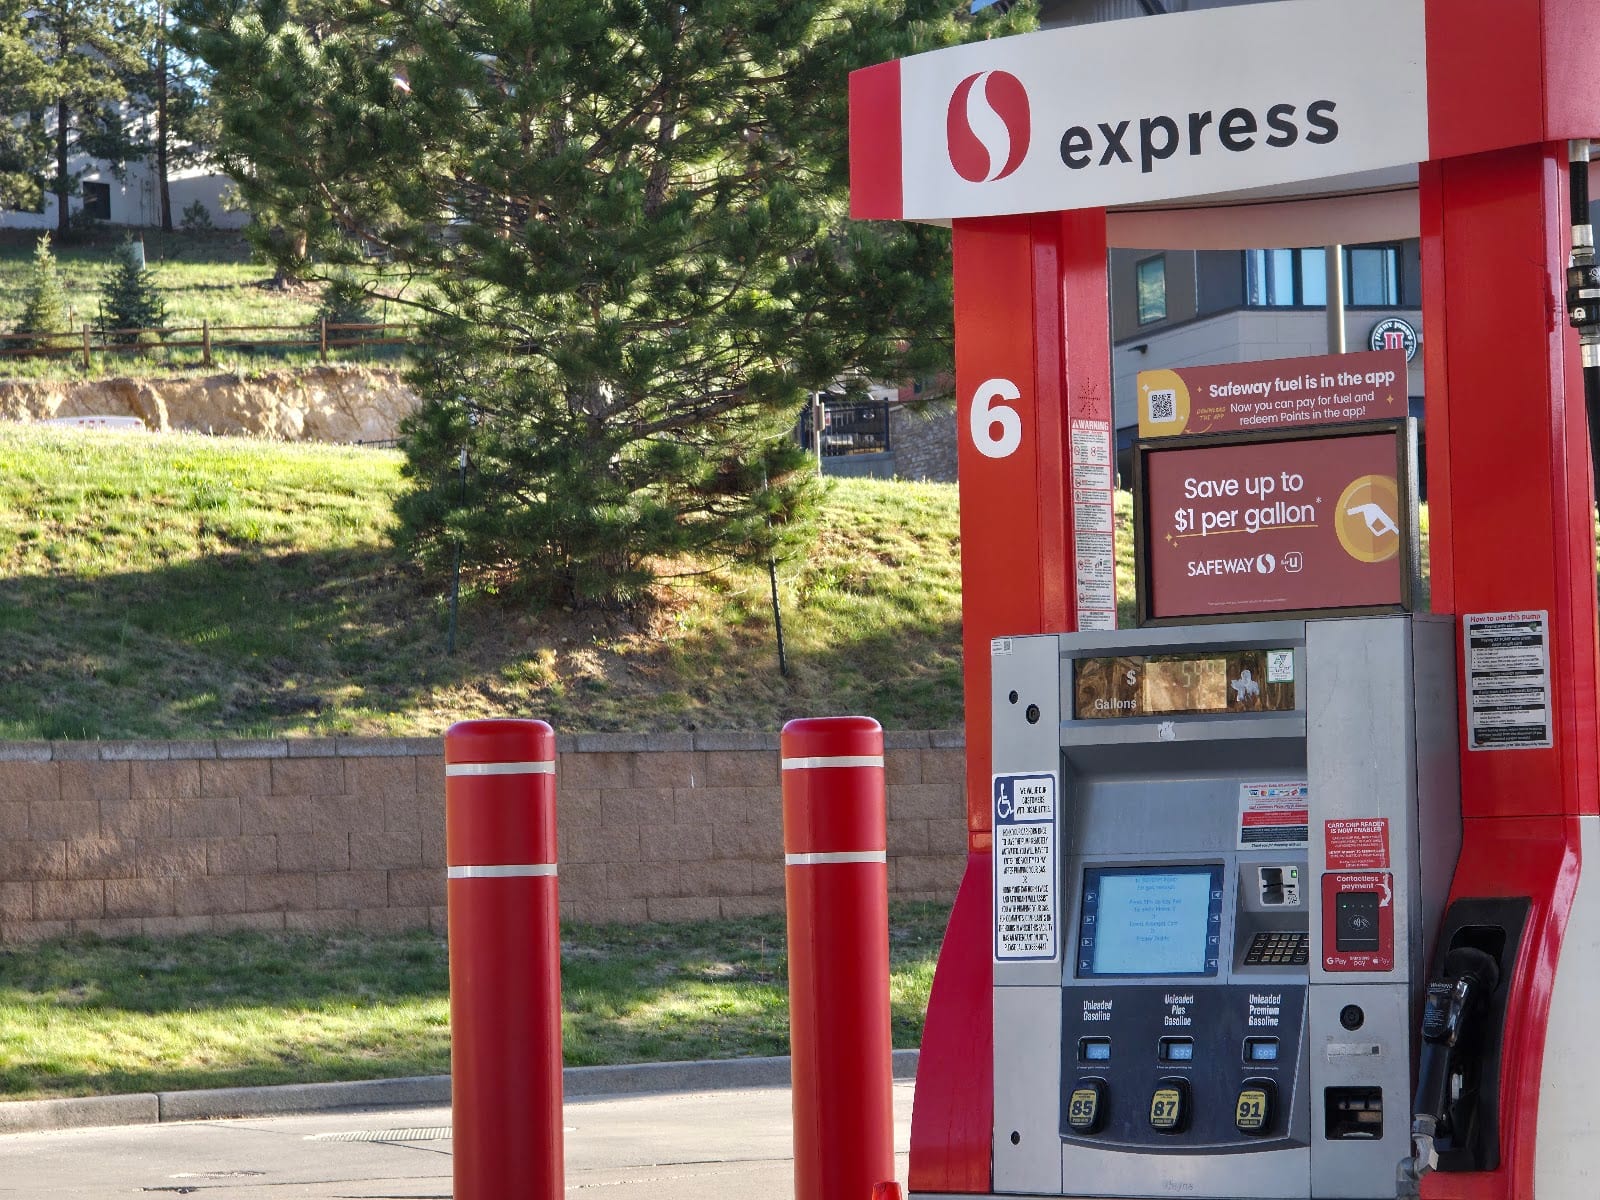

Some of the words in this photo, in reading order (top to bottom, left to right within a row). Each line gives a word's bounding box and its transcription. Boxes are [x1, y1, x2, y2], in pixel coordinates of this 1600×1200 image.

[1060, 100, 1339, 173] express
[1209, 380, 1271, 398] Safeway
[1275, 376, 1302, 391] fuel
[1305, 375, 1318, 389] is
[1321, 373, 1335, 388] in
[1338, 372, 1362, 387] the
[1365, 370, 1395, 388] app
[1230, 402, 1252, 413] Now
[1254, 402, 1272, 416] you
[1275, 400, 1293, 409] can
[1296, 399, 1315, 410] pay
[1318, 395, 1331, 405] for
[1333, 393, 1352, 404] fuel
[1354, 391, 1375, 402] and
[971, 379, 1021, 458] 6
[1239, 414, 1279, 426] redeem
[1280, 411, 1311, 422] Points
[1312, 409, 1322, 419] in
[1324, 408, 1340, 418] the
[1343, 406, 1366, 420] app!
[1079, 420, 1109, 430] WARNING
[1184, 477, 1239, 499] Save
[1245, 476, 1275, 501] up
[1281, 471, 1304, 492] to
[1174, 507, 1194, 532] $1
[1201, 509, 1239, 537] per
[1187, 557, 1255, 577] SAFEWAY
[1470, 615, 1486, 623] How
[1486, 614, 1494, 622] to
[1508, 613, 1521, 621] this
[1521, 613, 1541, 622] pump
[1126, 669, 1137, 687] $
[1094, 698, 1137, 710] Gallons
[1341, 883, 1374, 891] payment
[1334, 958, 1347, 966] Pay
[1083, 999, 1113, 1010] Unleaded
[1164, 994, 1194, 1005] Unleaded
[1249, 994, 1281, 1005] Unleaded
[1083, 1011, 1111, 1021] Gasoline
[1171, 1005, 1186, 1015] Plus
[1249, 1005, 1280, 1015] Premium
[1164, 1016, 1192, 1026] Gasoline
[1248, 1016, 1279, 1026] Gasoline
[1072, 1100, 1094, 1116] 85
[1153, 1100, 1177, 1117] 87
[1239, 1101, 1262, 1118] 91
